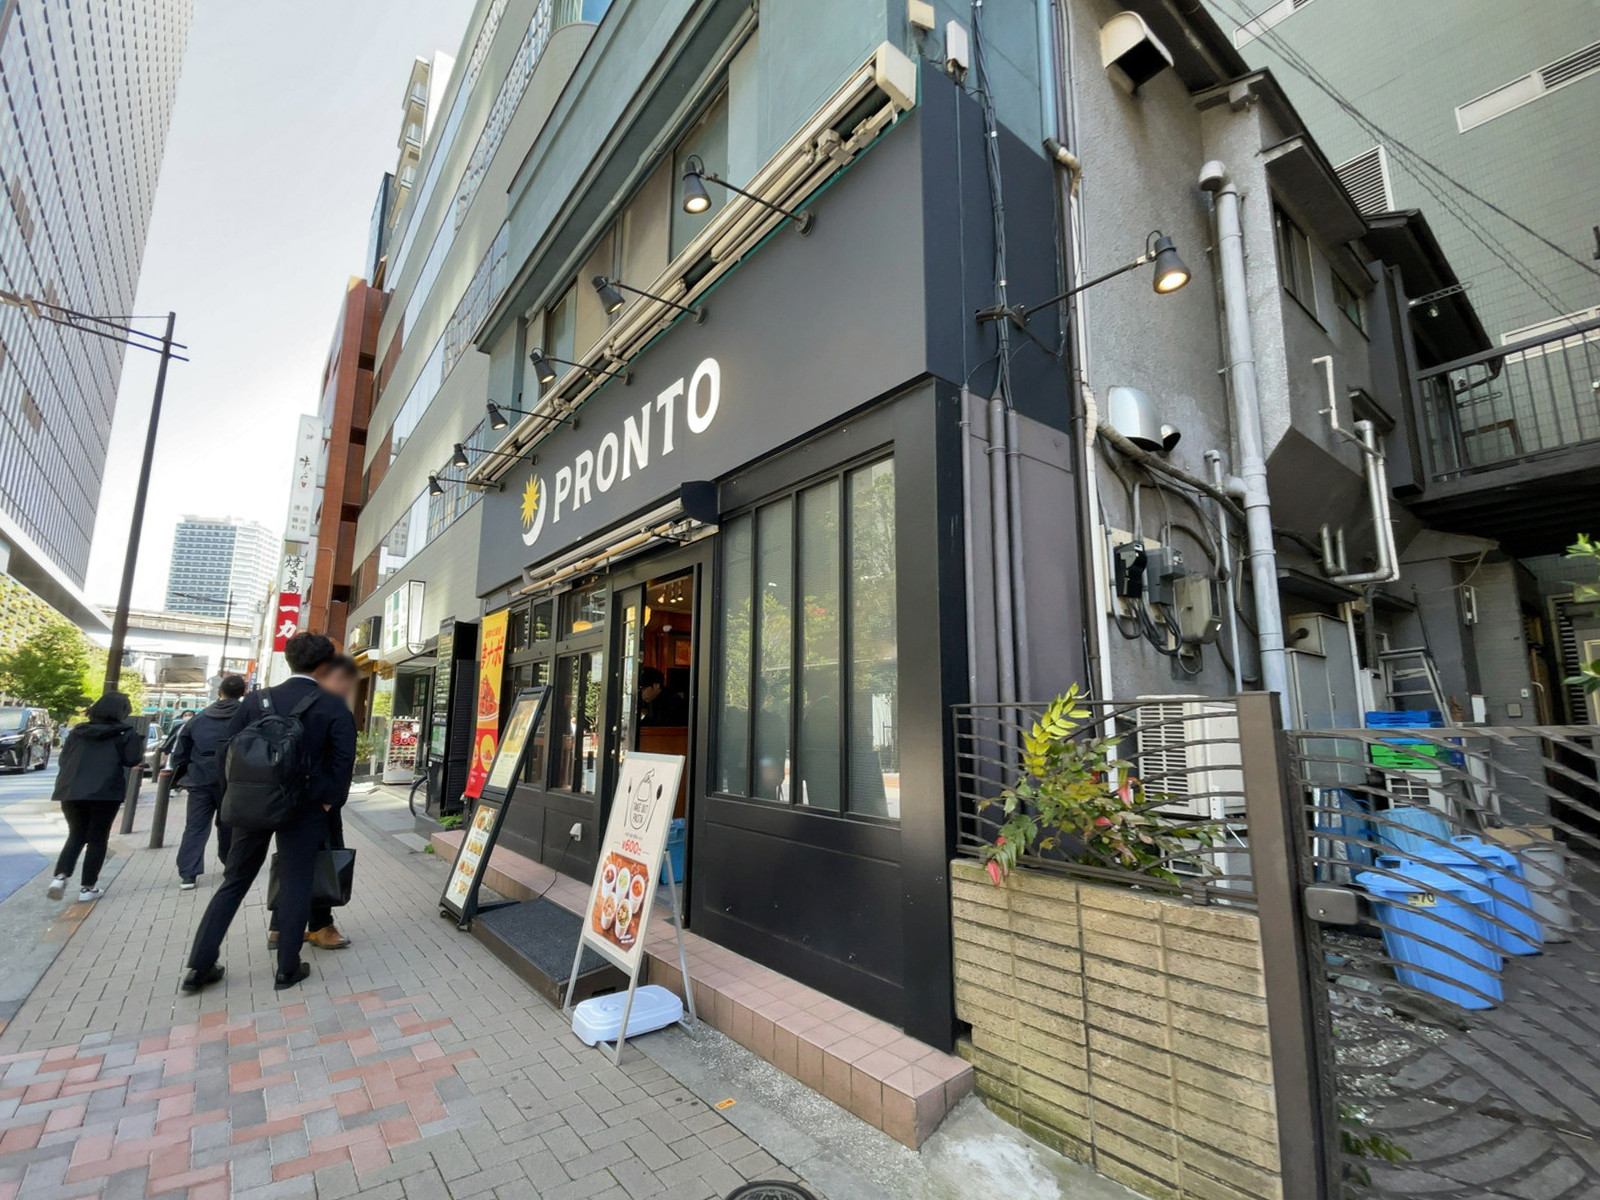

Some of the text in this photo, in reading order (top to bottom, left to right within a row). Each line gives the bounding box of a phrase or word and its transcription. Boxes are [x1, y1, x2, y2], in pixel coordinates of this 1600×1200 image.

[552, 357, 721, 524] PRONTO
[283, 554, 303, 595] 焼き鳥
